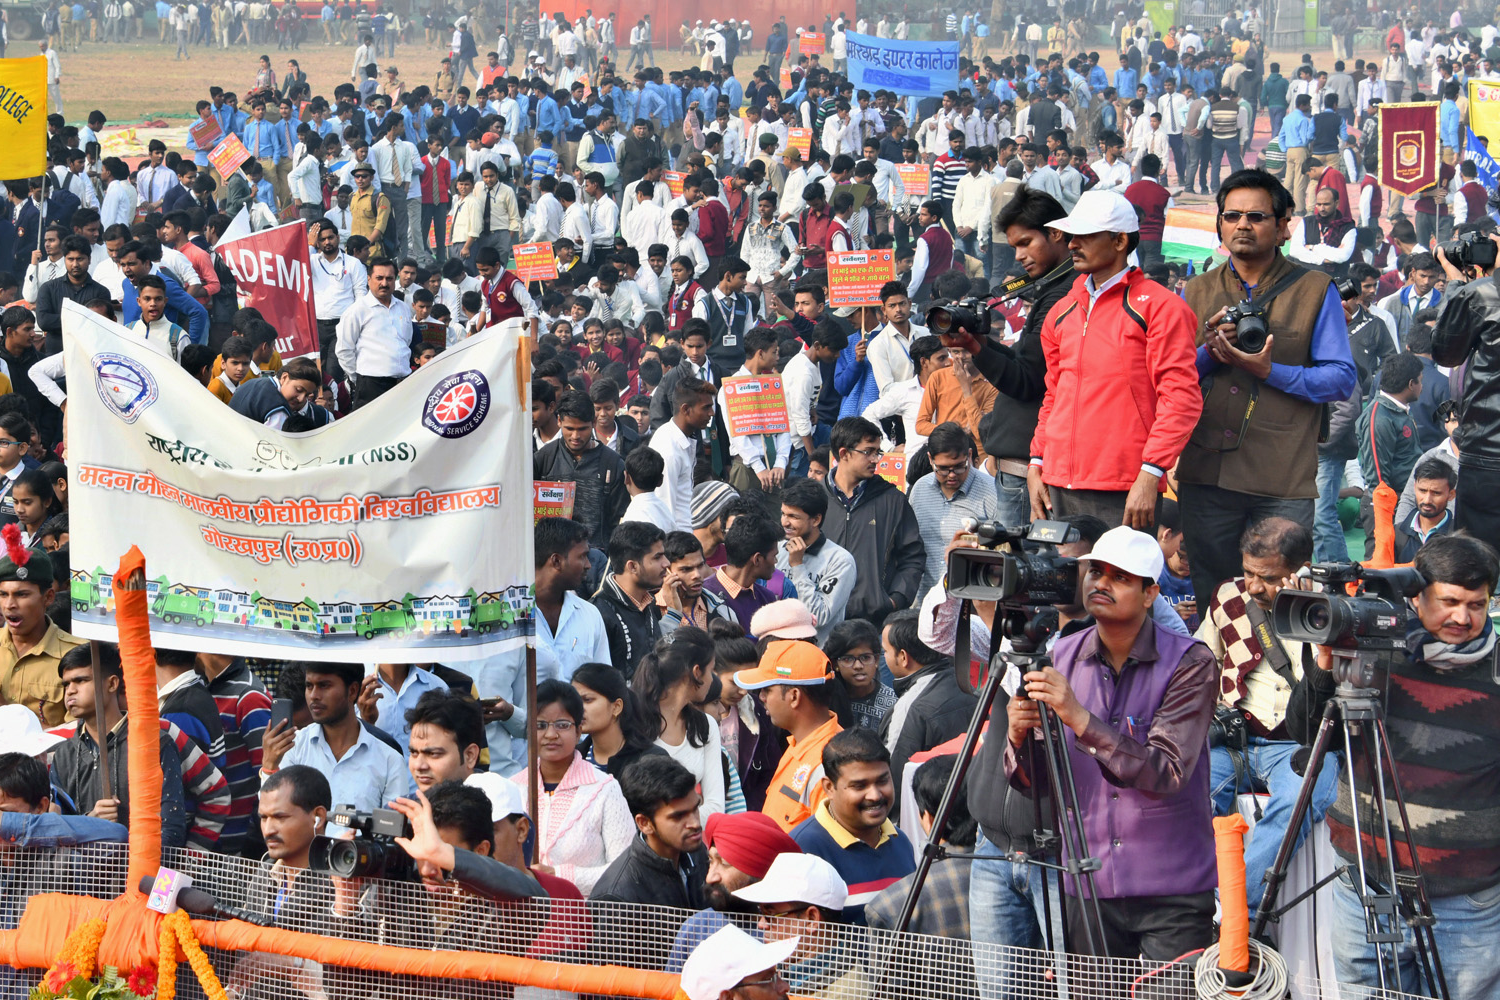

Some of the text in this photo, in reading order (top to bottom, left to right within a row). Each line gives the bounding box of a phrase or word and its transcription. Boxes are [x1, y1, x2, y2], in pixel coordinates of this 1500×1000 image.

[1006, 279, 1026, 291] Nikon
[362, 441, 418, 466] (NSS)
[79, 465, 500, 525] मदन मोहन मालवीय प्रौद्योगिकी विश्वविद्यालय
[202, 526, 282, 563] गोरखपुर
[1258, 623, 1273, 649] Nikon
